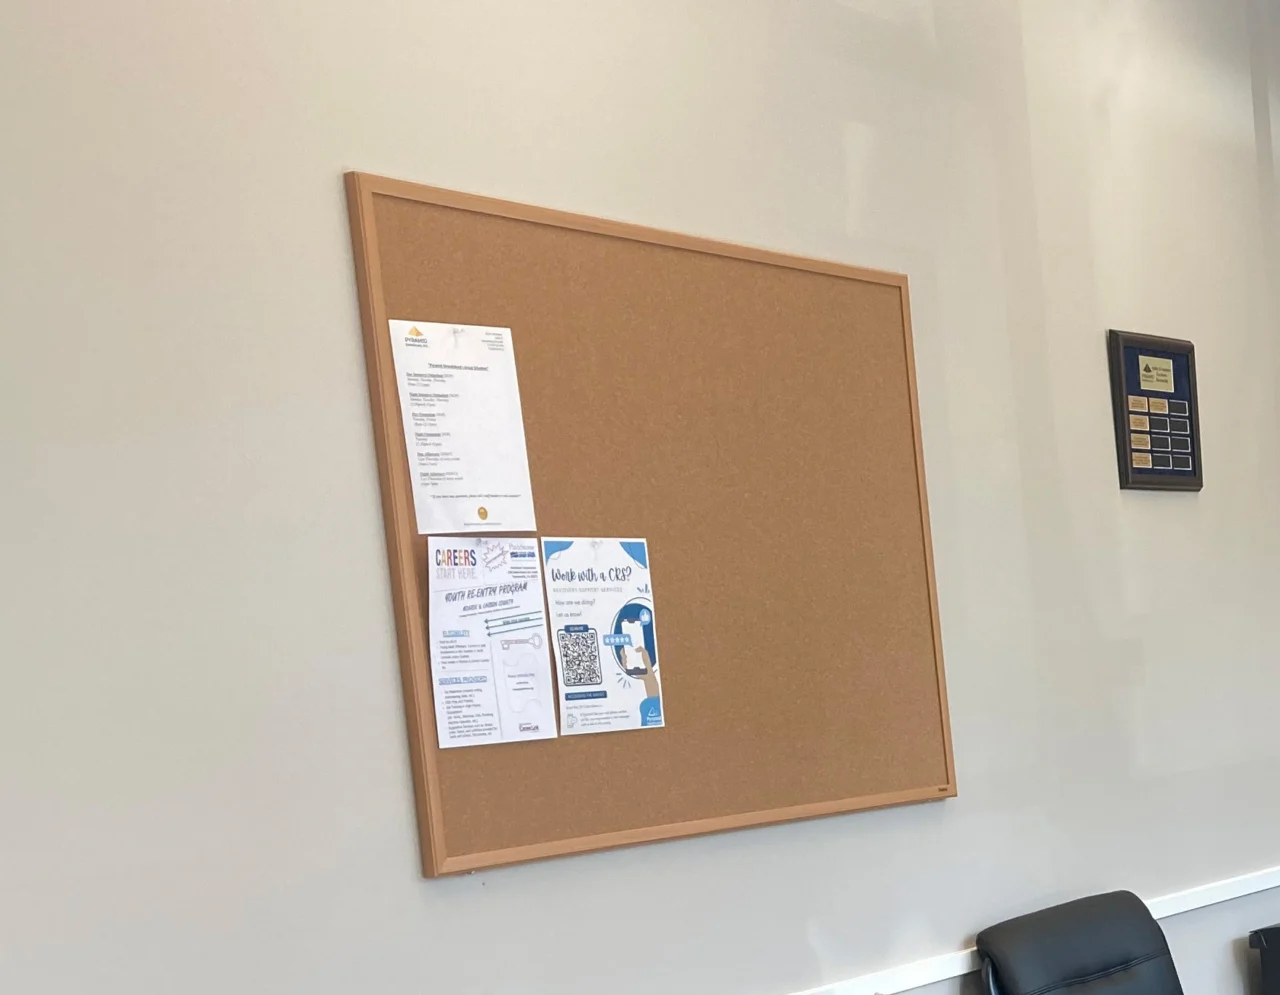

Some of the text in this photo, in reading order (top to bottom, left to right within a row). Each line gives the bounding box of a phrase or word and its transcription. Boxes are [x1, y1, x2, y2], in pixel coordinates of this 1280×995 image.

[435, 549, 476, 567] CAREERS
[436, 568, 455, 579] START
[551, 567, 577, 582] Work
[578, 567, 598, 582] with
[600, 572, 606, 582] a
[609, 566, 632, 581] CRS?
[445, 582, 528, 603] YOUTH RE-ENTRY PROGRAM
